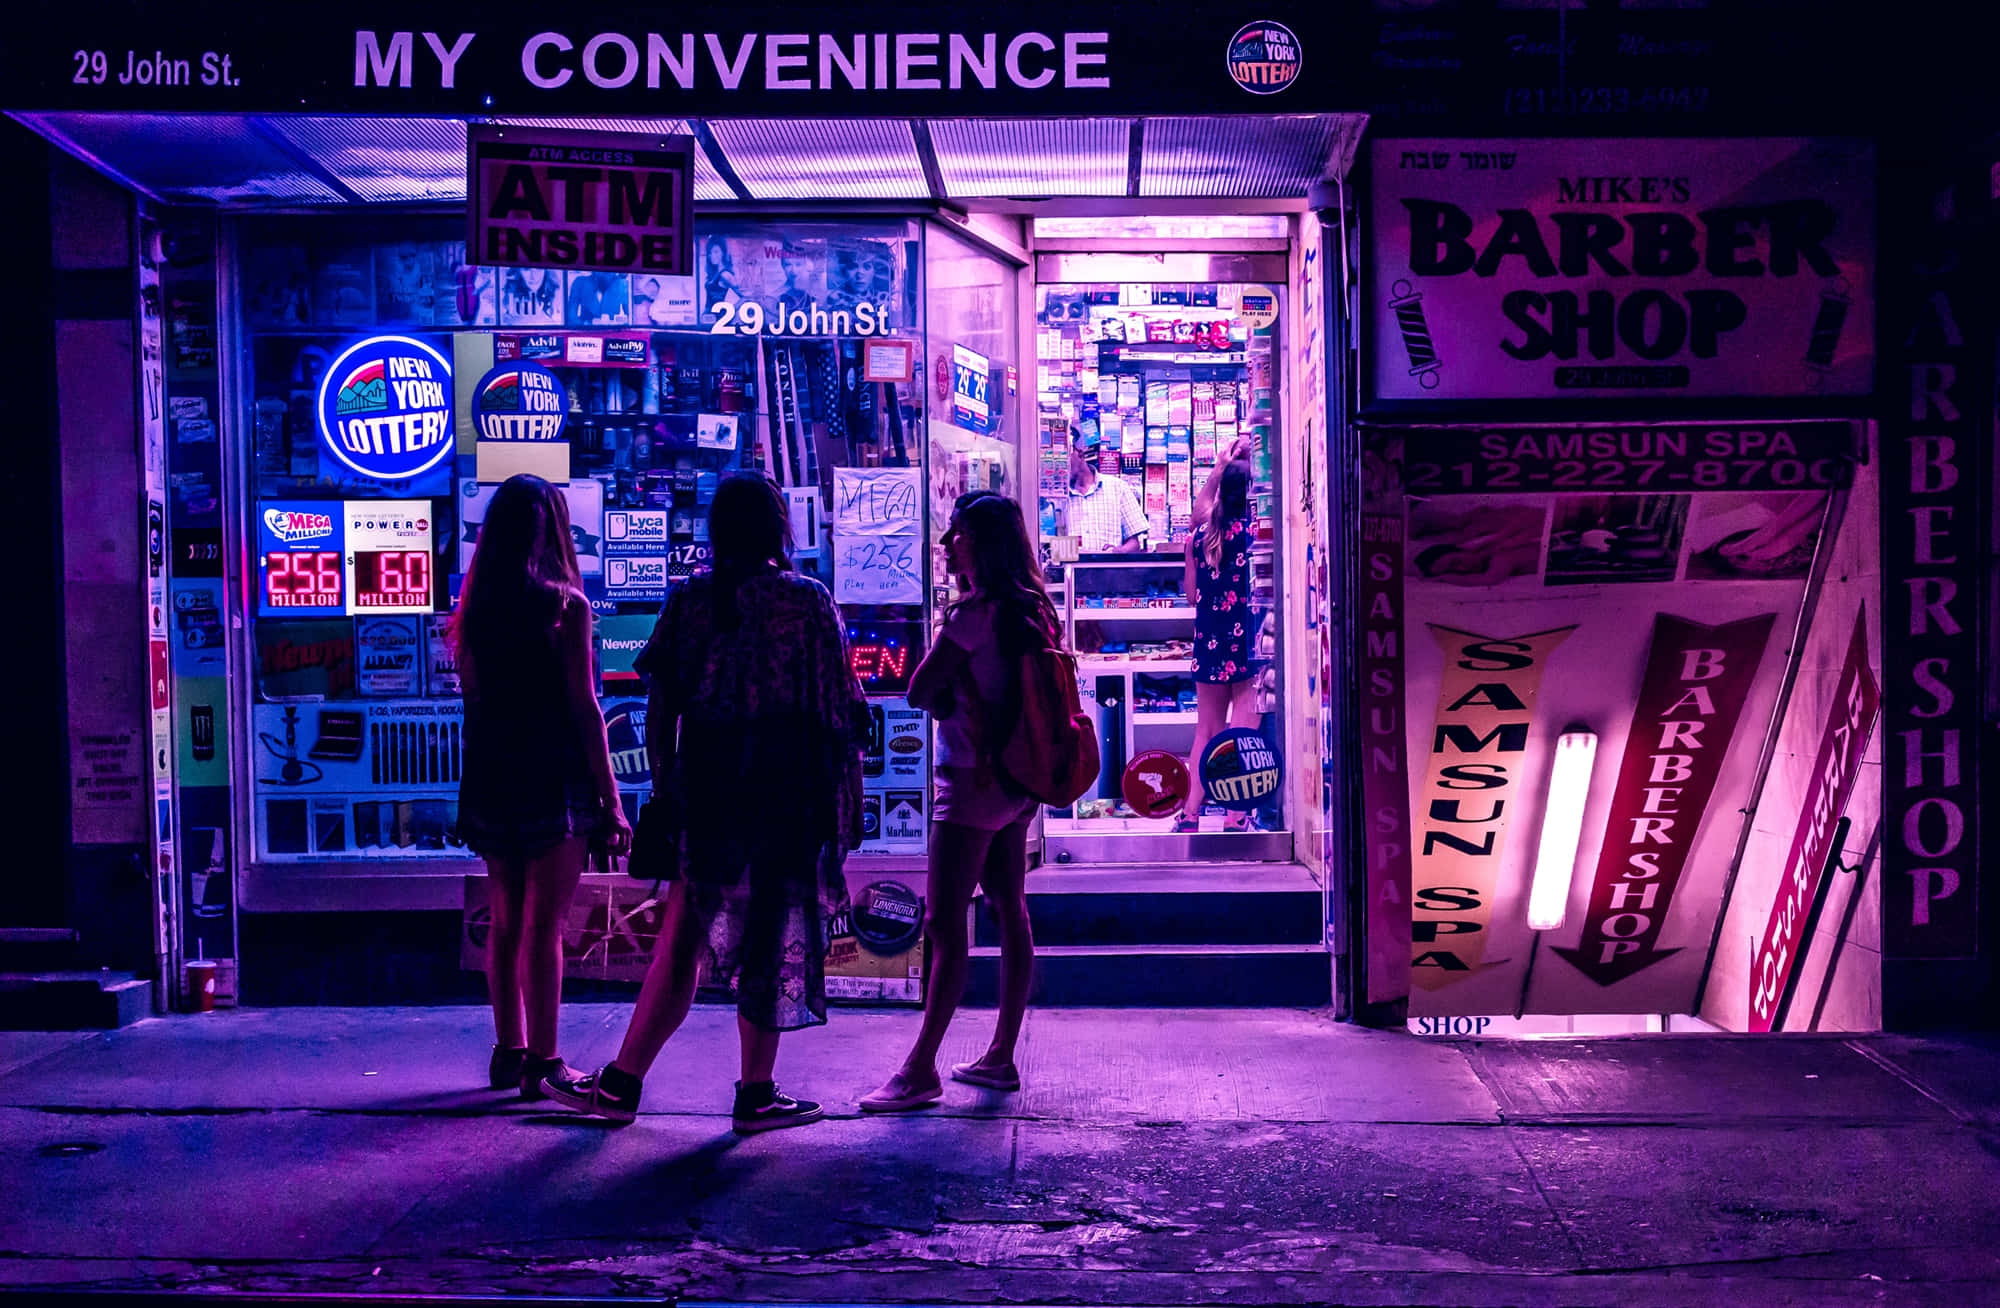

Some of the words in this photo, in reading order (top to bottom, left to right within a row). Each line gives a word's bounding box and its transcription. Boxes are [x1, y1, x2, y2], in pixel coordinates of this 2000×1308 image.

[1264, 29, 1289, 45] NEW
[354, 31, 476, 88] MY
[521, 31, 1111, 91] CONVENIENCE
[1265, 43, 1296, 61] YORK
[73, 50, 108, 85] 29
[118, 50, 191, 86] John
[200, 51, 241, 87] St.
[1231, 61, 1297, 85] LOTTERY
[528, 147, 565, 161] ATM
[567, 149, 635, 165] ACCESS
[489, 164, 674, 227] ATM
[1558, 176, 1691, 204] MIKE'S
[487, 226, 673, 268] INSIDE
[1402, 198, 1841, 278] BARBER
[710, 301, 765, 336] 29
[768, 301, 850, 336] John
[854, 301, 898, 336] St.
[1500, 290, 1748, 360] SHOP
[527, 336, 558, 347] Advil
[388, 356, 433, 380] NEW
[521, 370, 554, 390] NEW
[392, 380, 446, 411] YORK
[522, 388, 561, 413] YORK
[337, 408, 450, 455] LOTTERY
[480, 413, 564, 441] LOTTERY
[1479, 430, 1688, 460] SAMSUN
[1703, 430, 1798, 457] SPA
[839, 479, 918, 522] MEGA
[287, 512, 331, 531] MEGA
[629, 514, 664, 528] Lyca
[629, 527, 664, 536] mobile
[607, 543, 644, 551] Available
[645, 543, 665, 551] Here
[841, 542, 913, 571] $256
[268, 552, 341, 594] 256
[380, 552, 428, 593] 60
[629, 561, 664, 575] Lyca
[629, 573, 664, 582] mobile
[271, 593, 338, 606] MILLION
[359, 593, 425, 606] MILLION
[602, 638, 649, 651] Newpo
[851, 646, 908, 678] EN
[1366, 552, 1398, 775] SAMSUN
[1237, 736, 1266, 751] NEW
[1421, 640, 1535, 857] SAMSUN
[1241, 750, 1276, 771] YORK
[1208, 768, 1280, 802] LOTTERY
[886, 821, 924, 838] Marlboro
[1374, 806, 1400, 904] SPA
[872, 898, 919, 918] LONGHORN
[1410, 886, 1484, 972] SPA
[1417, 1016, 1491, 1035] SHOP
